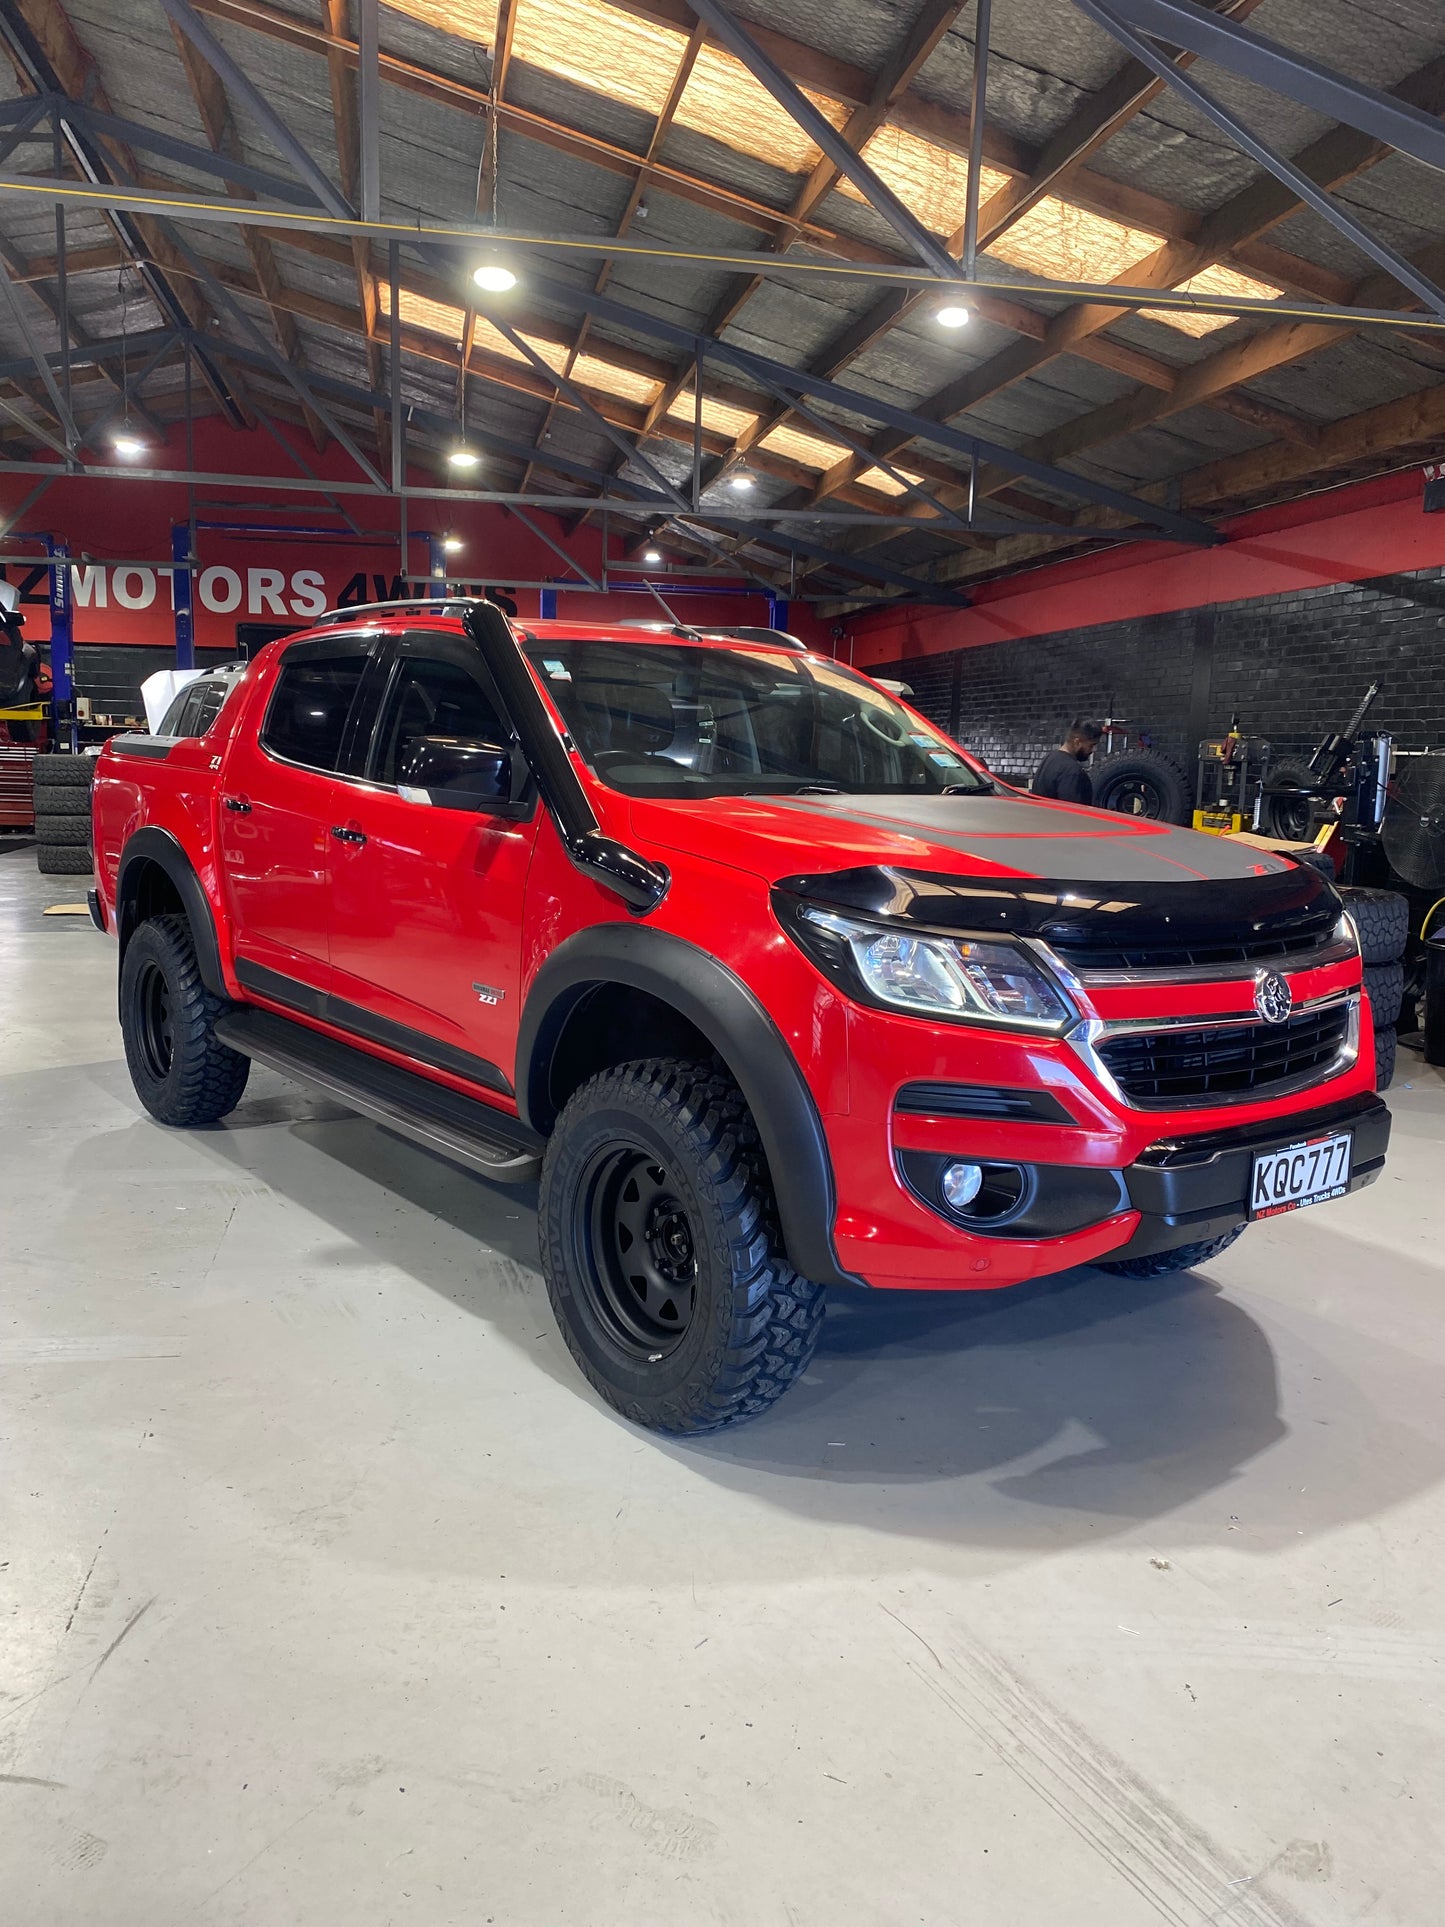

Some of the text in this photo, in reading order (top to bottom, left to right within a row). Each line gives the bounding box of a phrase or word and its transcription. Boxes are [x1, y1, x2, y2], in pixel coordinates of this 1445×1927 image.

[0, 563, 51, 605] Z
[337, 573, 518, 620] 4W'S
[53, 547, 66, 609] Summt
[1254, 1141, 1348, 1204] KQC777
[1256, 1210, 1266, 1220] NZ
[1266, 1205, 1287, 1217] Motors
